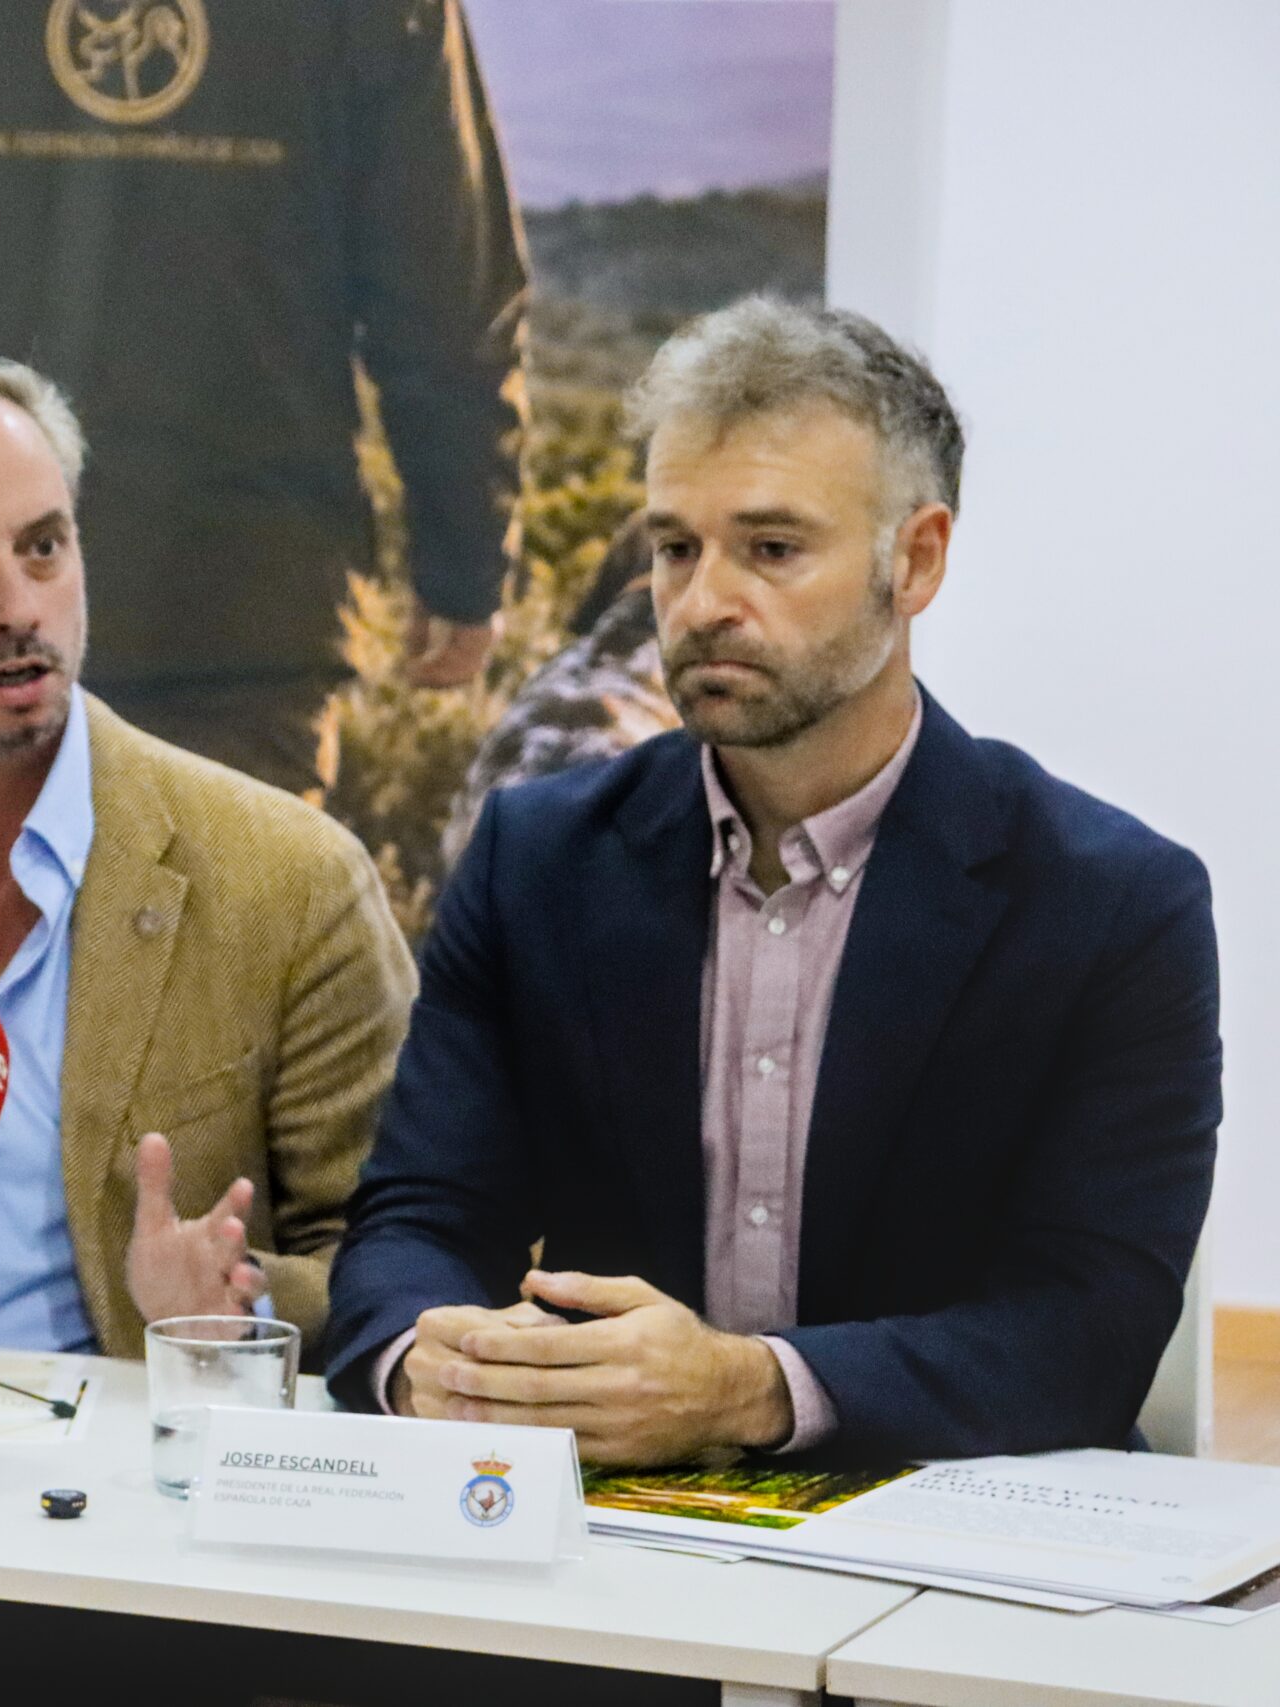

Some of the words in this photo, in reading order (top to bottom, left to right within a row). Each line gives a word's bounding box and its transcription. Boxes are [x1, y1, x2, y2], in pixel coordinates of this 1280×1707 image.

[220, 1451, 274, 1468] JOSEP
[279, 1455, 378, 1477] ESCANDELL
[214, 1491, 266, 1505] ESPAÑOLA
[269, 1496, 282, 1506] DE
[285, 1497, 312, 1508] CAZA
[216, 1478, 277, 1492] PRESIDENTE
[280, 1482, 293, 1493] DE
[296, 1484, 309, 1494] LA
[311, 1485, 335, 1497] REAL
[338, 1486, 405, 1501] FEDERACIÓN
